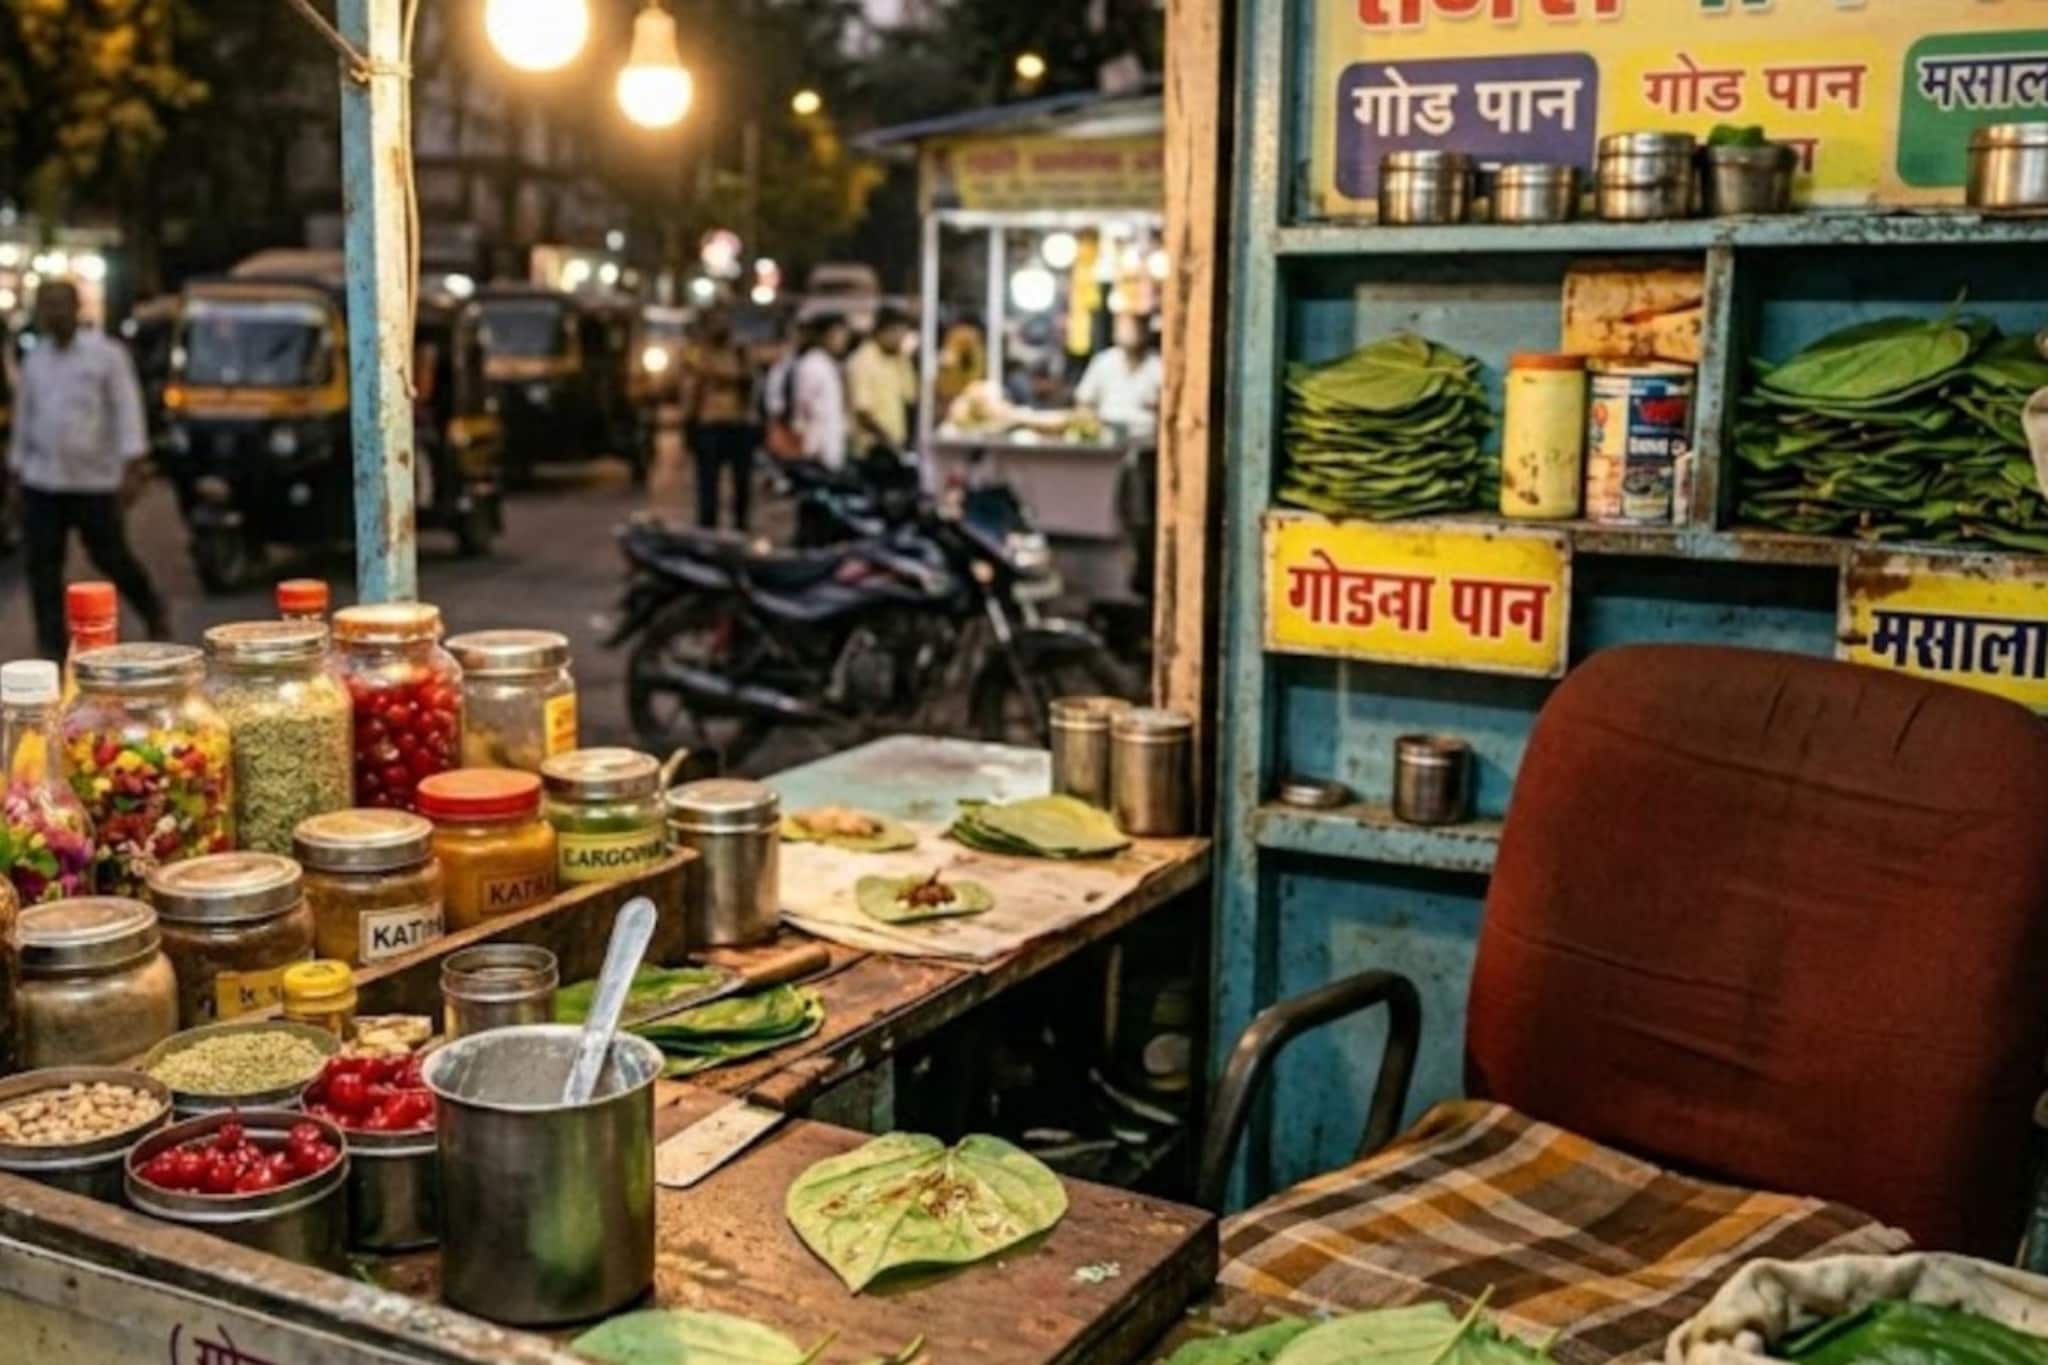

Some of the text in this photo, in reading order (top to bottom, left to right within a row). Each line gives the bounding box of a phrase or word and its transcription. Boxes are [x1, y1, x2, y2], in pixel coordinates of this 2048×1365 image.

[1351, 67, 1583, 137] गोड पान
[1643, 53, 1867, 112] गोड पान
[1451, 579, 1551, 642] पान
[1871, 610, 2047, 679] मसाला
